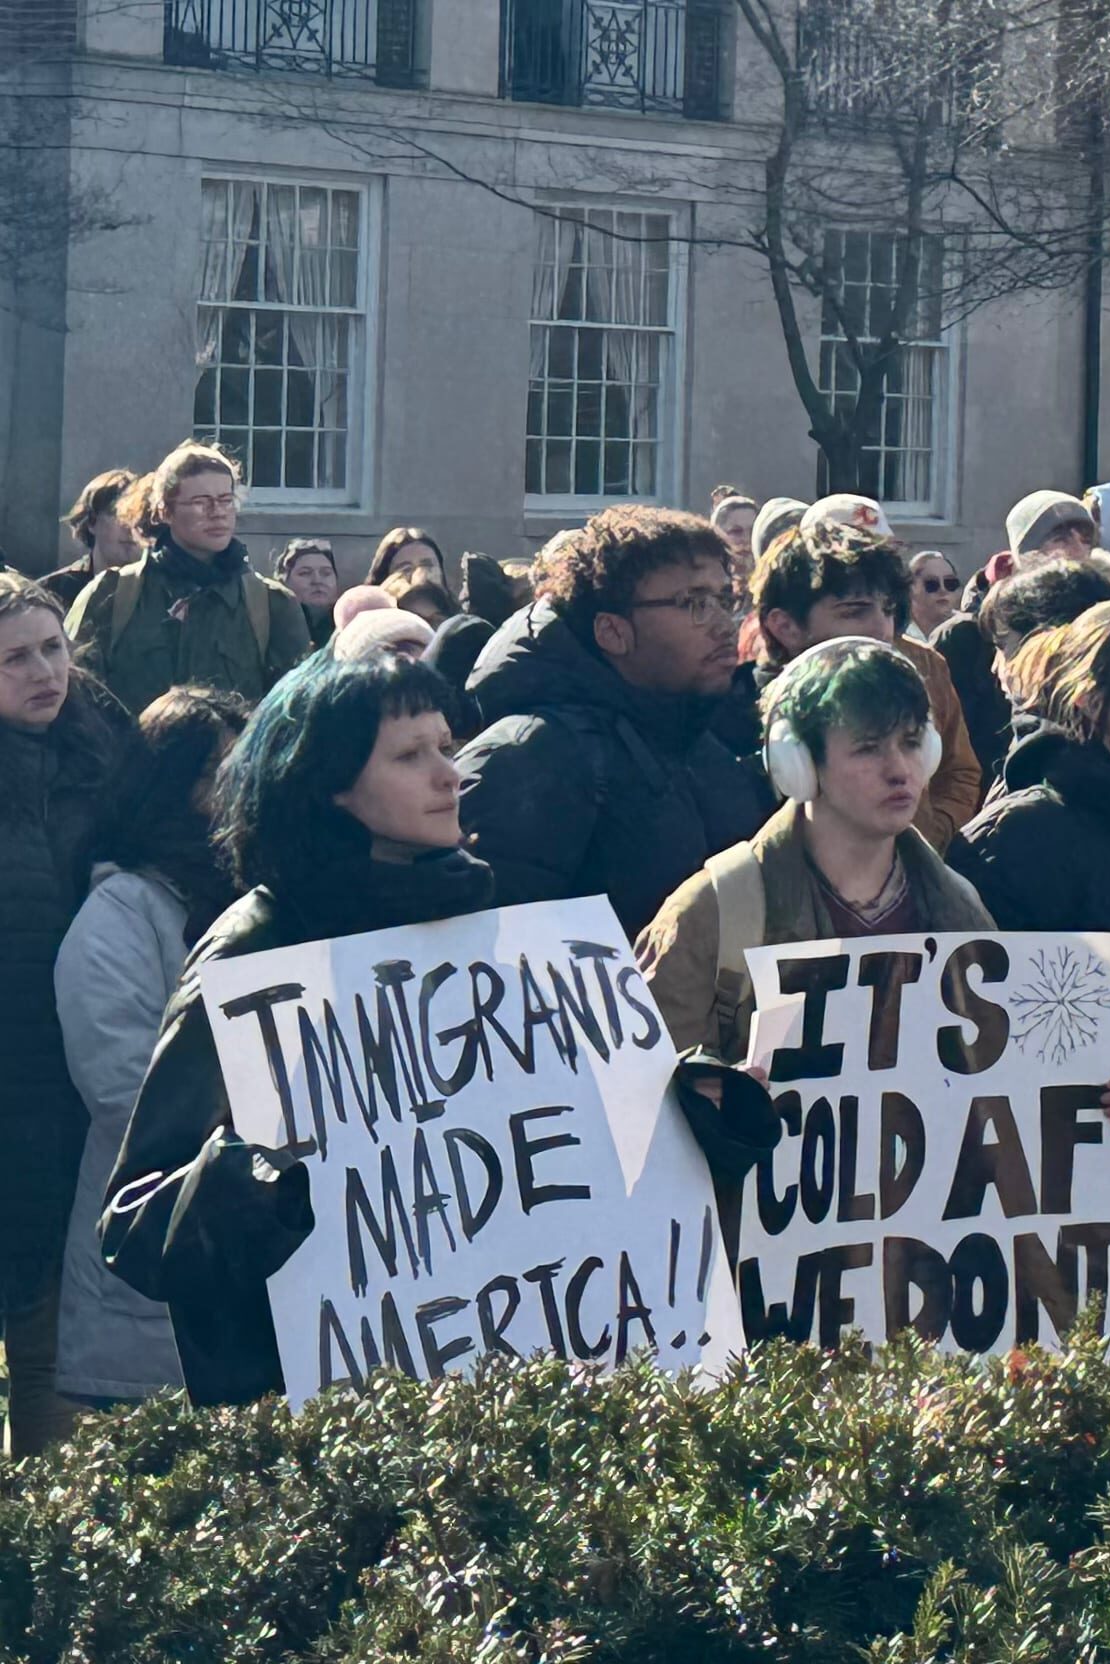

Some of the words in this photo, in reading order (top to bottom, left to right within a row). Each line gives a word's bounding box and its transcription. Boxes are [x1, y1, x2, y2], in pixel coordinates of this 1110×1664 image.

[219, 939, 662, 1162] IMMIGRANTS
[769, 937, 1011, 1083] IT'S
[345, 1105, 591, 1298] MADE
[756, 1089, 926, 1236] COLD
[942, 1084, 1108, 1222] AF
[318, 1204, 712, 1396] AMERICA!!
[738, 1242, 873, 1357] WE
